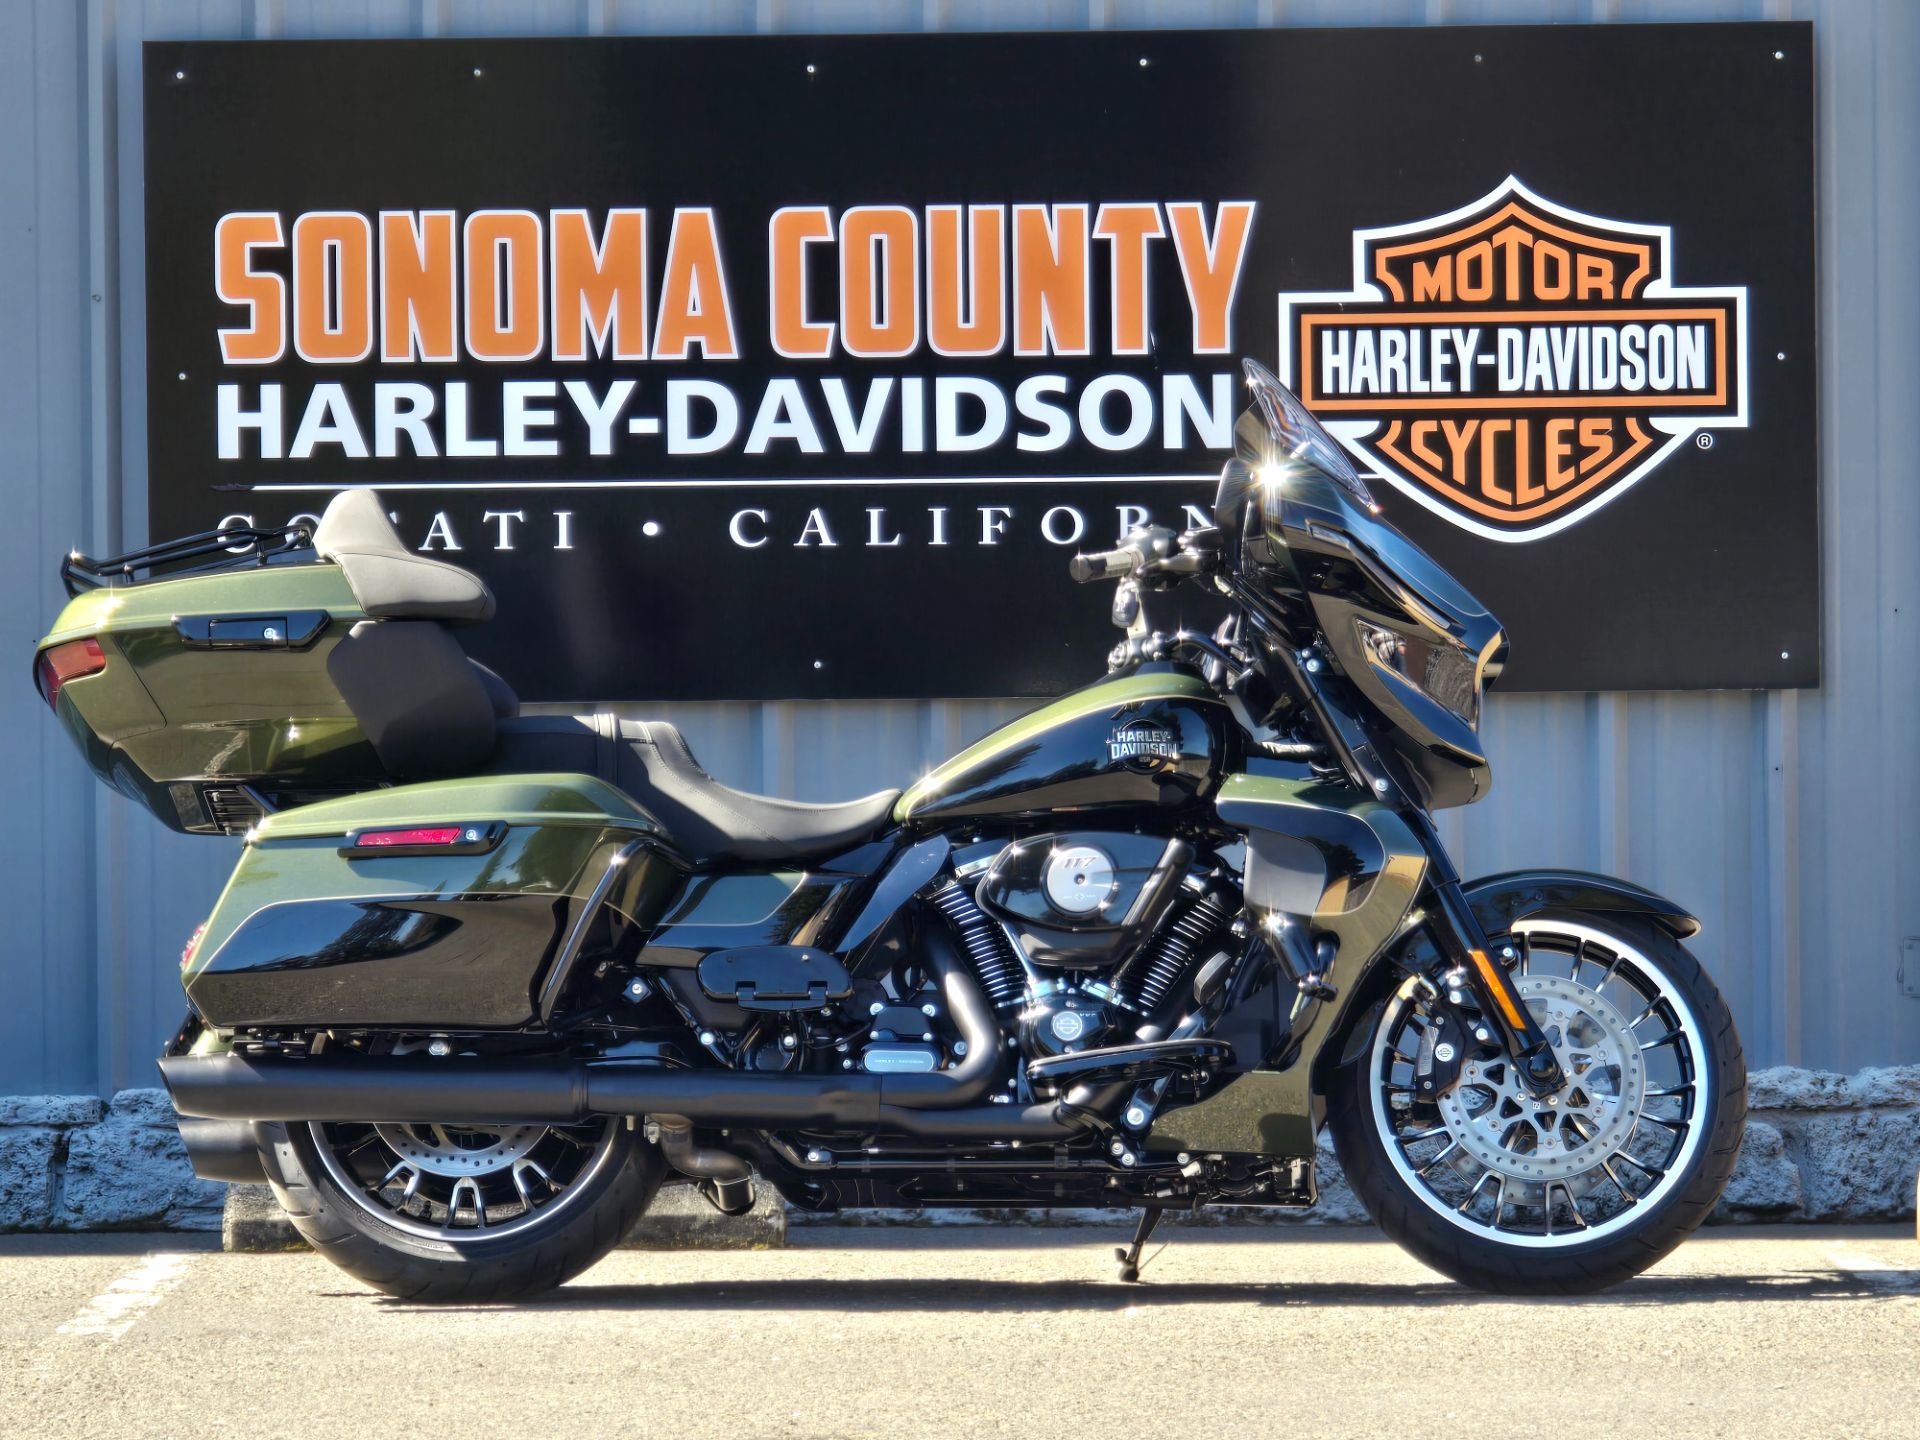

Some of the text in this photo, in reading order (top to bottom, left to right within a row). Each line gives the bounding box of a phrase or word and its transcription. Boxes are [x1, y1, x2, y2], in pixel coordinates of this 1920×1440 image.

[214, 201, 1256, 364] SONOMA COUNTY
[1412, 225, 1614, 302] MOTOR
[1321, 324, 1706, 394] HARLEY-DAVIDSON
[217, 374, 1233, 459] HARLEY-DAVIDSON
[1411, 417, 1614, 505] CYCLES
[217, 510, 573, 553] CATI
[1111, 742, 1178, 760] DAVIDSON
[1116, 730, 1171, 742] HARLEY-
